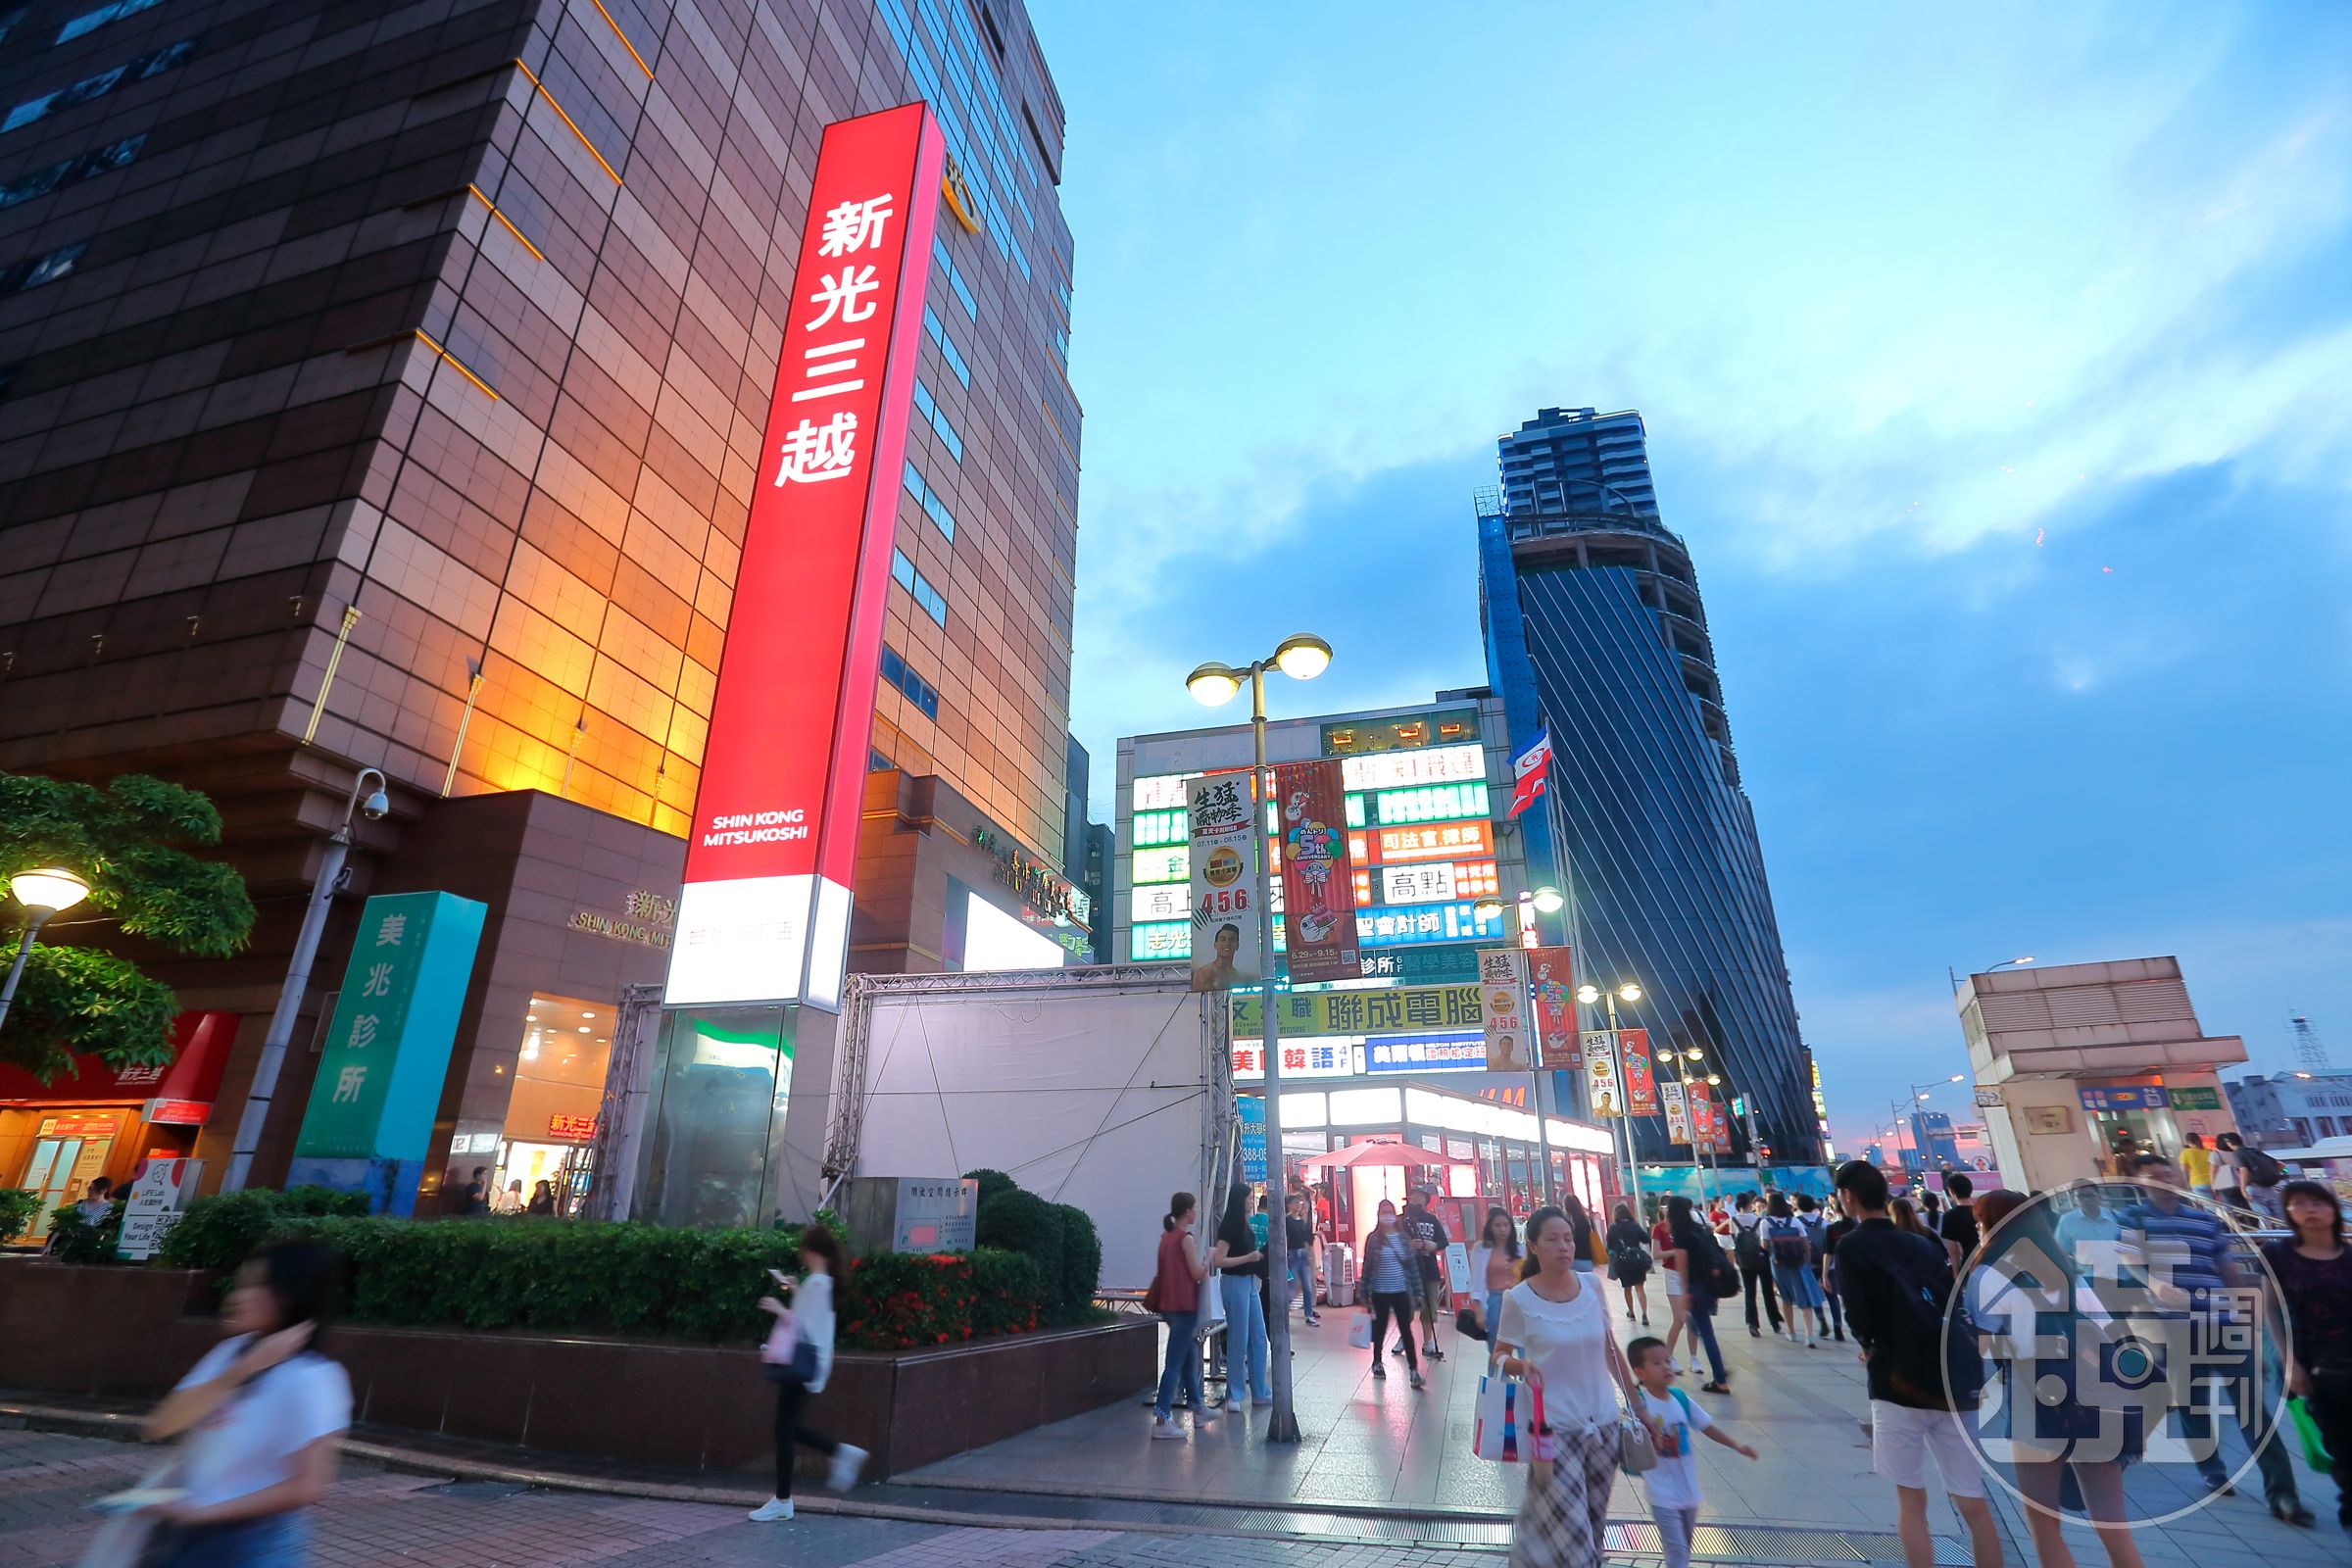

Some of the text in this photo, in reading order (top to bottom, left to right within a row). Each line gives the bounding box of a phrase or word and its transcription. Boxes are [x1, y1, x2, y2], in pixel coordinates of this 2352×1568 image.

[774, 192, 893, 488] 新光三越
[1195, 781, 1240, 812] 生猛
[712, 808, 804, 830] SHIN KONG
[704, 825, 808, 847] MITSUKOSHI
[1391, 870, 1447, 898] 高點
[578, 912, 609, 931] SHIN
[613, 921, 646, 940] KONG
[332, 913, 408, 1103] 美兆診所
[1232, 997, 1312, 1021] 文職
[1326, 988, 1484, 1031] 聯成電腦
[1233, 1047, 1334, 1071] 美韓語
[133, 1222, 154, 1233] Design
